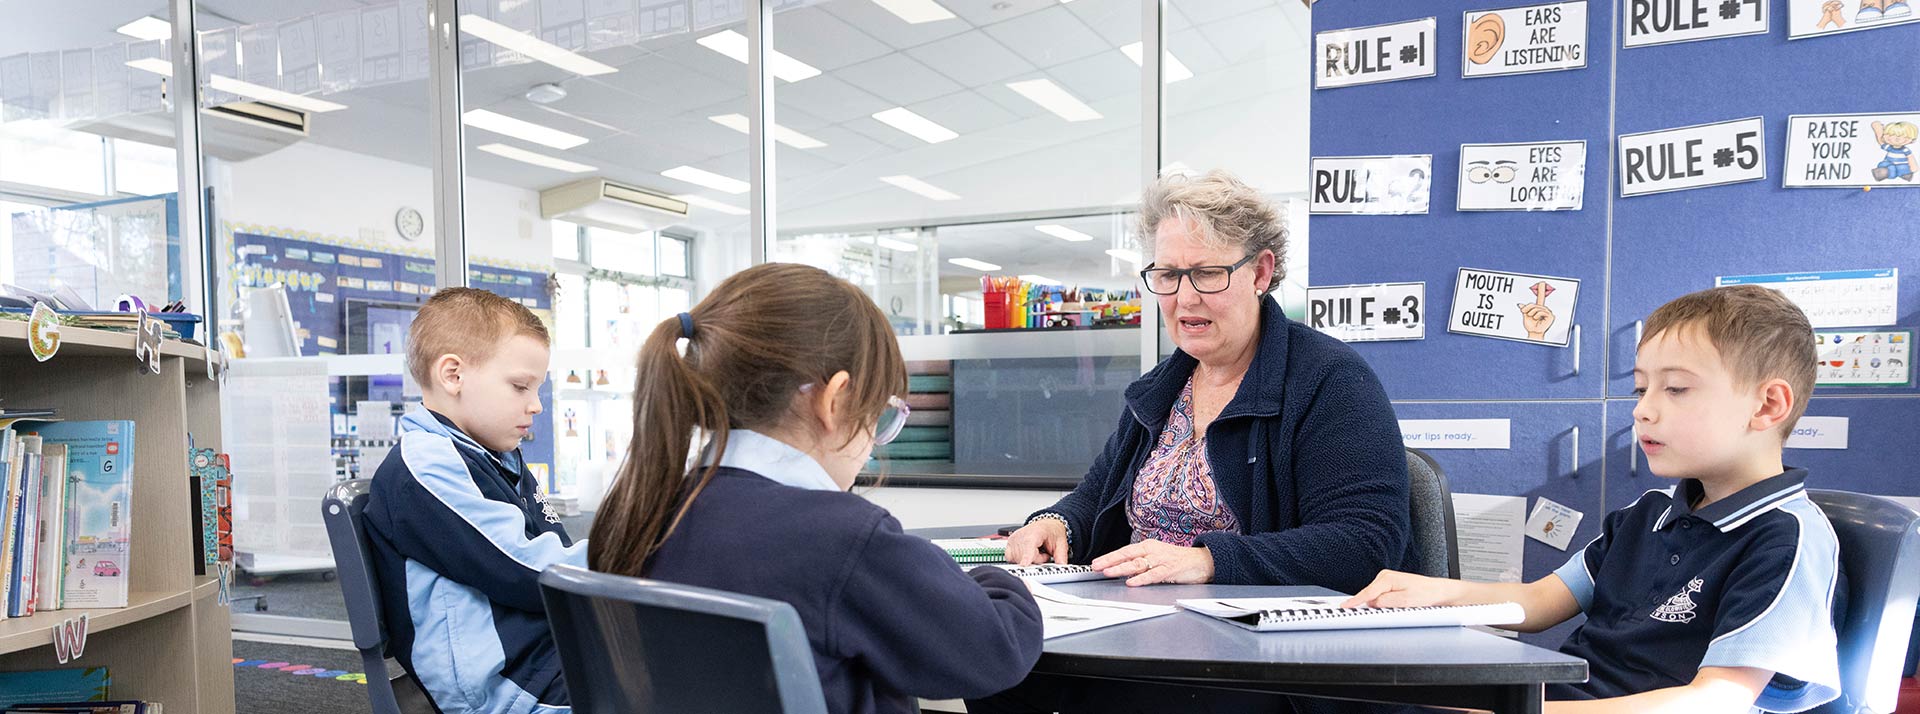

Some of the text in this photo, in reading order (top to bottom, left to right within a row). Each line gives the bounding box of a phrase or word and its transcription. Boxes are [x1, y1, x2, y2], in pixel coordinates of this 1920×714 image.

[1525, 7, 1562, 26] EARS
[1631, 0, 1709, 36] RULE
[1529, 27, 1556, 45] ARE
[1326, 31, 1425, 78] RULE #1
[1505, 44, 1581, 66] LISTENING
[1807, 120, 1859, 138] RAISE
[1529, 146, 1562, 163] EYES
[1626, 131, 1758, 185] RULE #5
[1811, 142, 1851, 160] YOUR
[1531, 166, 1558, 183] ARE
[1805, 163, 1851, 180] HAND
[1465, 273, 1514, 293] MOUTH
[1477, 294, 1494, 310] IS
[1311, 296, 1419, 329] RULE #3
[1461, 311, 1504, 330] QUIET
[1425, 432, 1440, 442] lips
[103, 460, 113, 473] G
[53, 613, 88, 664] W
